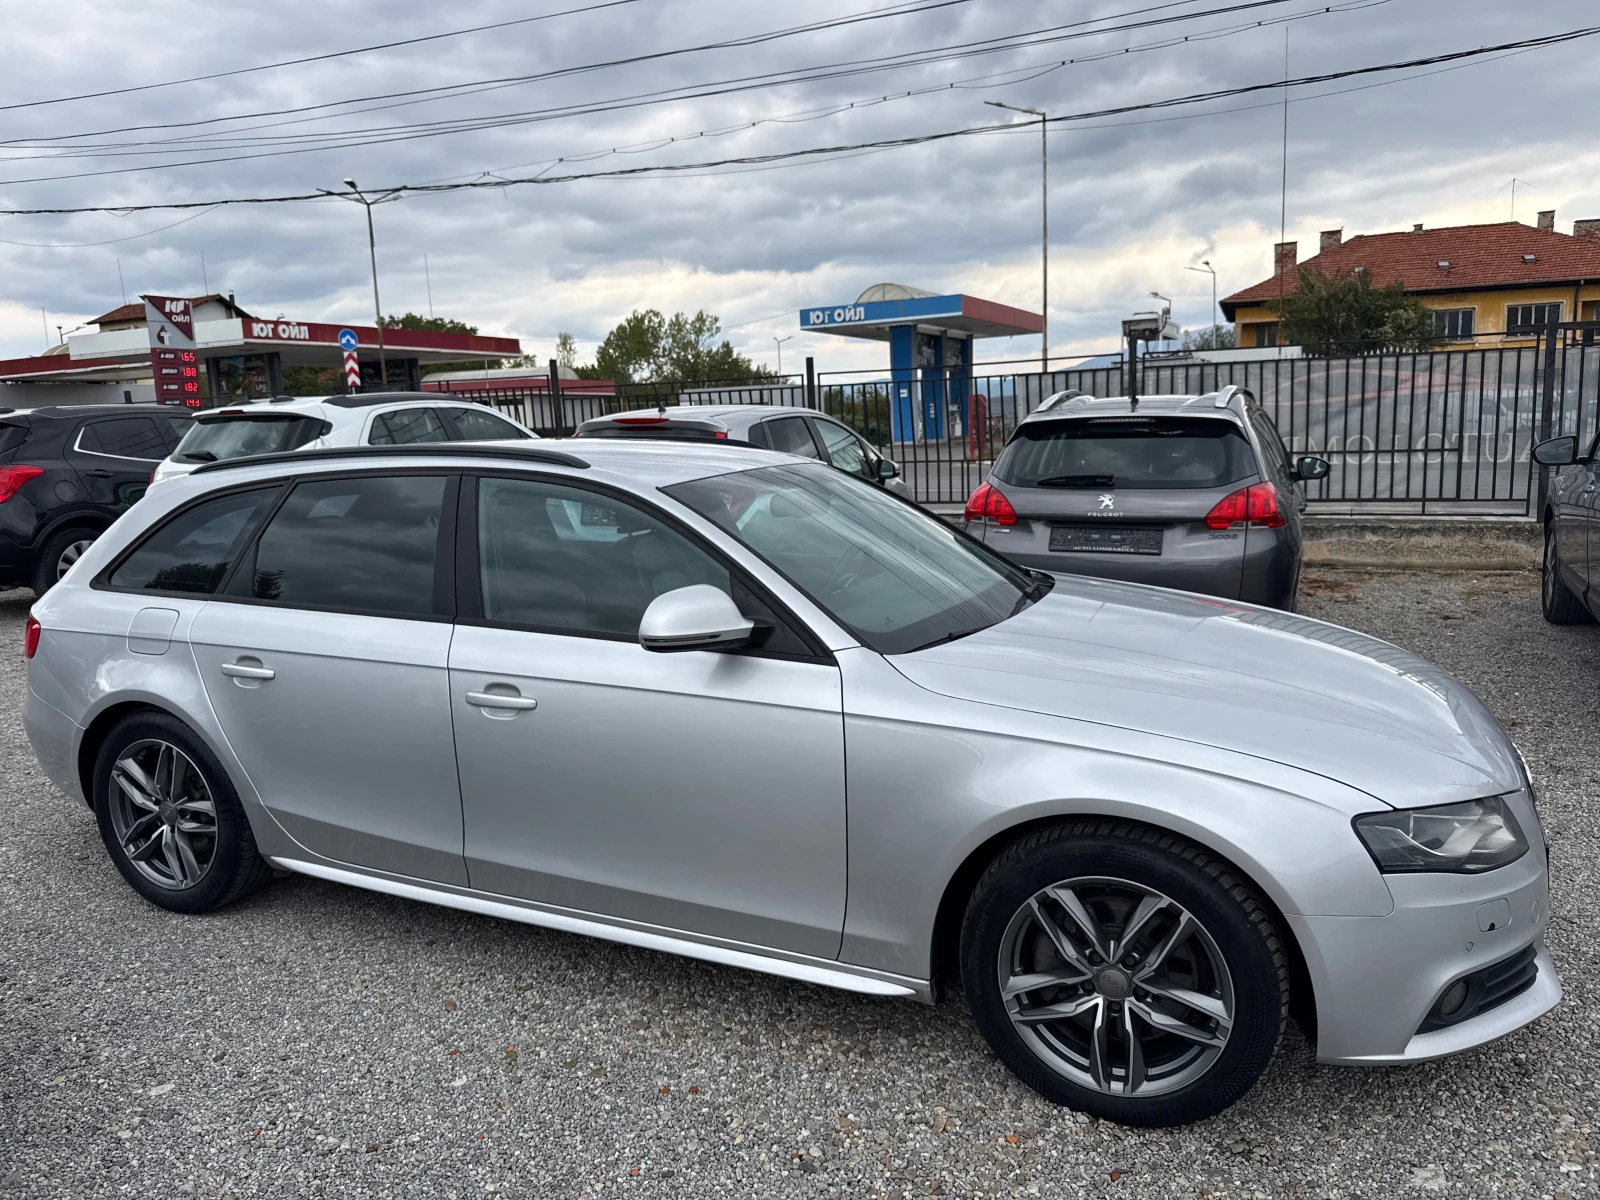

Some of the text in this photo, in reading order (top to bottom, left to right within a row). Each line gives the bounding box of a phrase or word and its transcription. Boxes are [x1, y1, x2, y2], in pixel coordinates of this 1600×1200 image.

[165, 300, 188, 313] ЮГ
[172, 314, 190, 323] ОЙЛ
[809, 305, 865, 325] ЮГ ОЙЛ
[252, 322, 309, 339] ЮГ ОЙЛ
